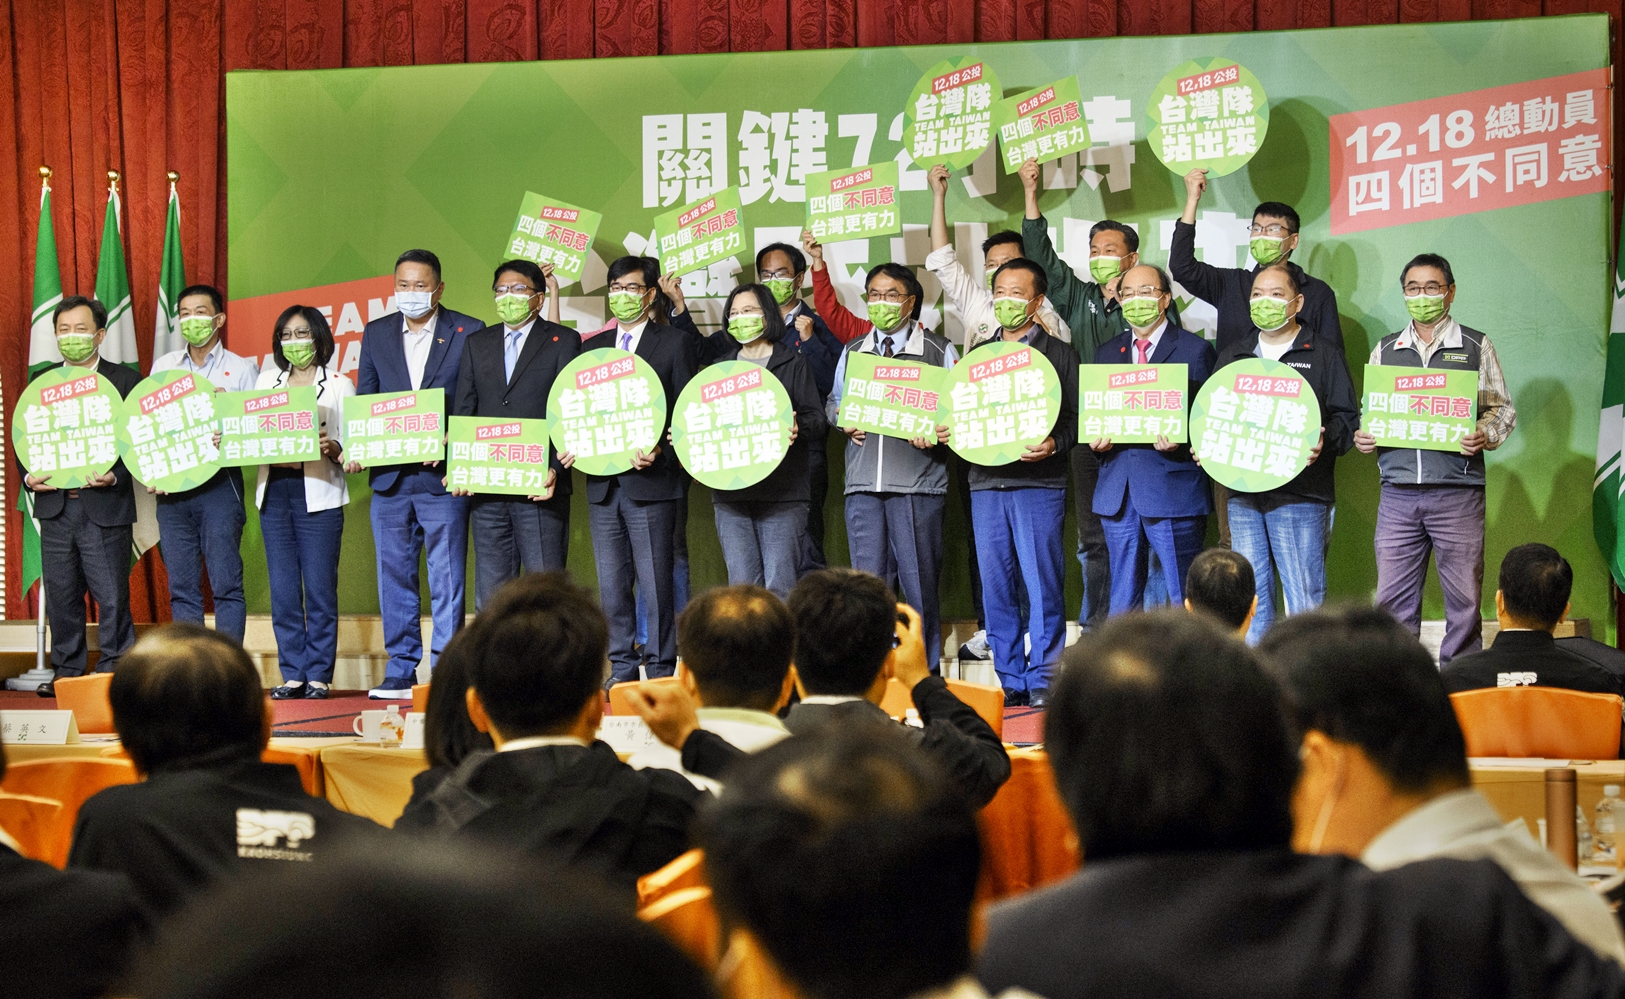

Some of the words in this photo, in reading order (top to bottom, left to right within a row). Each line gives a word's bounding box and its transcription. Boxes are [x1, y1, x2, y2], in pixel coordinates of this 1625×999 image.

[962, 66, 981, 82] 公投
[1214, 68, 1237, 84] 公投
[914, 82, 991, 121] 台灣隊
[1039, 89, 1054, 101] 公投
[1158, 86, 1254, 124] 台灣隊
[915, 119, 944, 132] TEAM
[950, 112, 990, 126] TAIWAN
[1001, 101, 1080, 142] 四個不同意
[1161, 122, 1197, 134] TEAM
[1204, 116, 1254, 130] TAIWAN
[1346, 109, 1475, 164] 12.18
[1484, 89, 1598, 141] 總動員
[913, 122, 990, 158] 站出來
[1007, 126, 1084, 166] 台灣更有力
[1162, 127, 1256, 163] 站出來
[856, 170, 871, 182] 公投
[1348, 134, 1602, 216] 四個不同意
[700, 200, 715, 212] 公投
[810, 186, 894, 214] 四個不同意
[563, 210, 578, 222] 公投
[811, 210, 894, 237] 台灣更有力
[517, 215, 590, 252] 四個不同意
[661, 210, 738, 253] 四個不同意
[510, 237, 582, 273] 台灣更有力
[664, 232, 740, 274] 台灣更有力
[611, 360, 634, 376] 公投
[1006, 352, 1029, 368] 公投
[74, 377, 97, 394] 公投
[737, 371, 760, 388] 公投
[902, 369, 919, 378] 公投
[1138, 371, 1157, 382] 公投
[1426, 376, 1445, 386] 公投
[172, 377, 196, 397] 公投
[271, 394, 288, 405] 公投
[558, 377, 650, 418] 台灣隊
[847, 378, 939, 411] 四個不同意
[950, 368, 1045, 411] 台灣隊
[1274, 380, 1300, 394] 公投
[398, 397, 416, 407] 公投
[683, 389, 777, 433] 台灣隊
[952, 409, 989, 422] TEAM
[995, 398, 1046, 414] TAIWAN
[1084, 390, 1182, 410] 四個不同意
[1208, 385, 1308, 435] 台灣隊
[1368, 392, 1472, 418] 四個不同意
[23, 394, 112, 434] 台灣隊
[126, 392, 214, 445] 台灣隊
[222, 411, 314, 436] 四個不同意
[348, 413, 440, 437] 四個不同意
[562, 416, 597, 430] TEAM
[603, 408, 651, 423] TAIWAN
[845, 403, 934, 435] 台灣更有力
[1084, 415, 1182, 436] 台灣更有力
[26, 432, 60, 444] TEAM
[67, 424, 114, 439] TAIWAN
[134, 438, 168, 455] TEAM
[173, 420, 218, 442] TAIWAN
[503, 425, 520, 434] 公投
[564, 420, 656, 458] 站出來
[687, 430, 723, 444] TEAM
[729, 421, 779, 437] TAIWAN
[954, 409, 1048, 451] 站出來
[1206, 418, 1244, 436] TEAM
[1250, 428, 1302, 448] TAIWAN
[1368, 418, 1470, 443] 台灣更有力
[28, 435, 116, 473] 站出來
[138, 433, 220, 483] 站出來
[224, 436, 314, 460] 台灣更有力
[349, 437, 438, 461] 台灣更有力
[452, 442, 544, 464] 四個不同意
[689, 432, 782, 474] 站出來
[1200, 429, 1300, 478] 站出來
[452, 466, 542, 488] 台灣更有力
